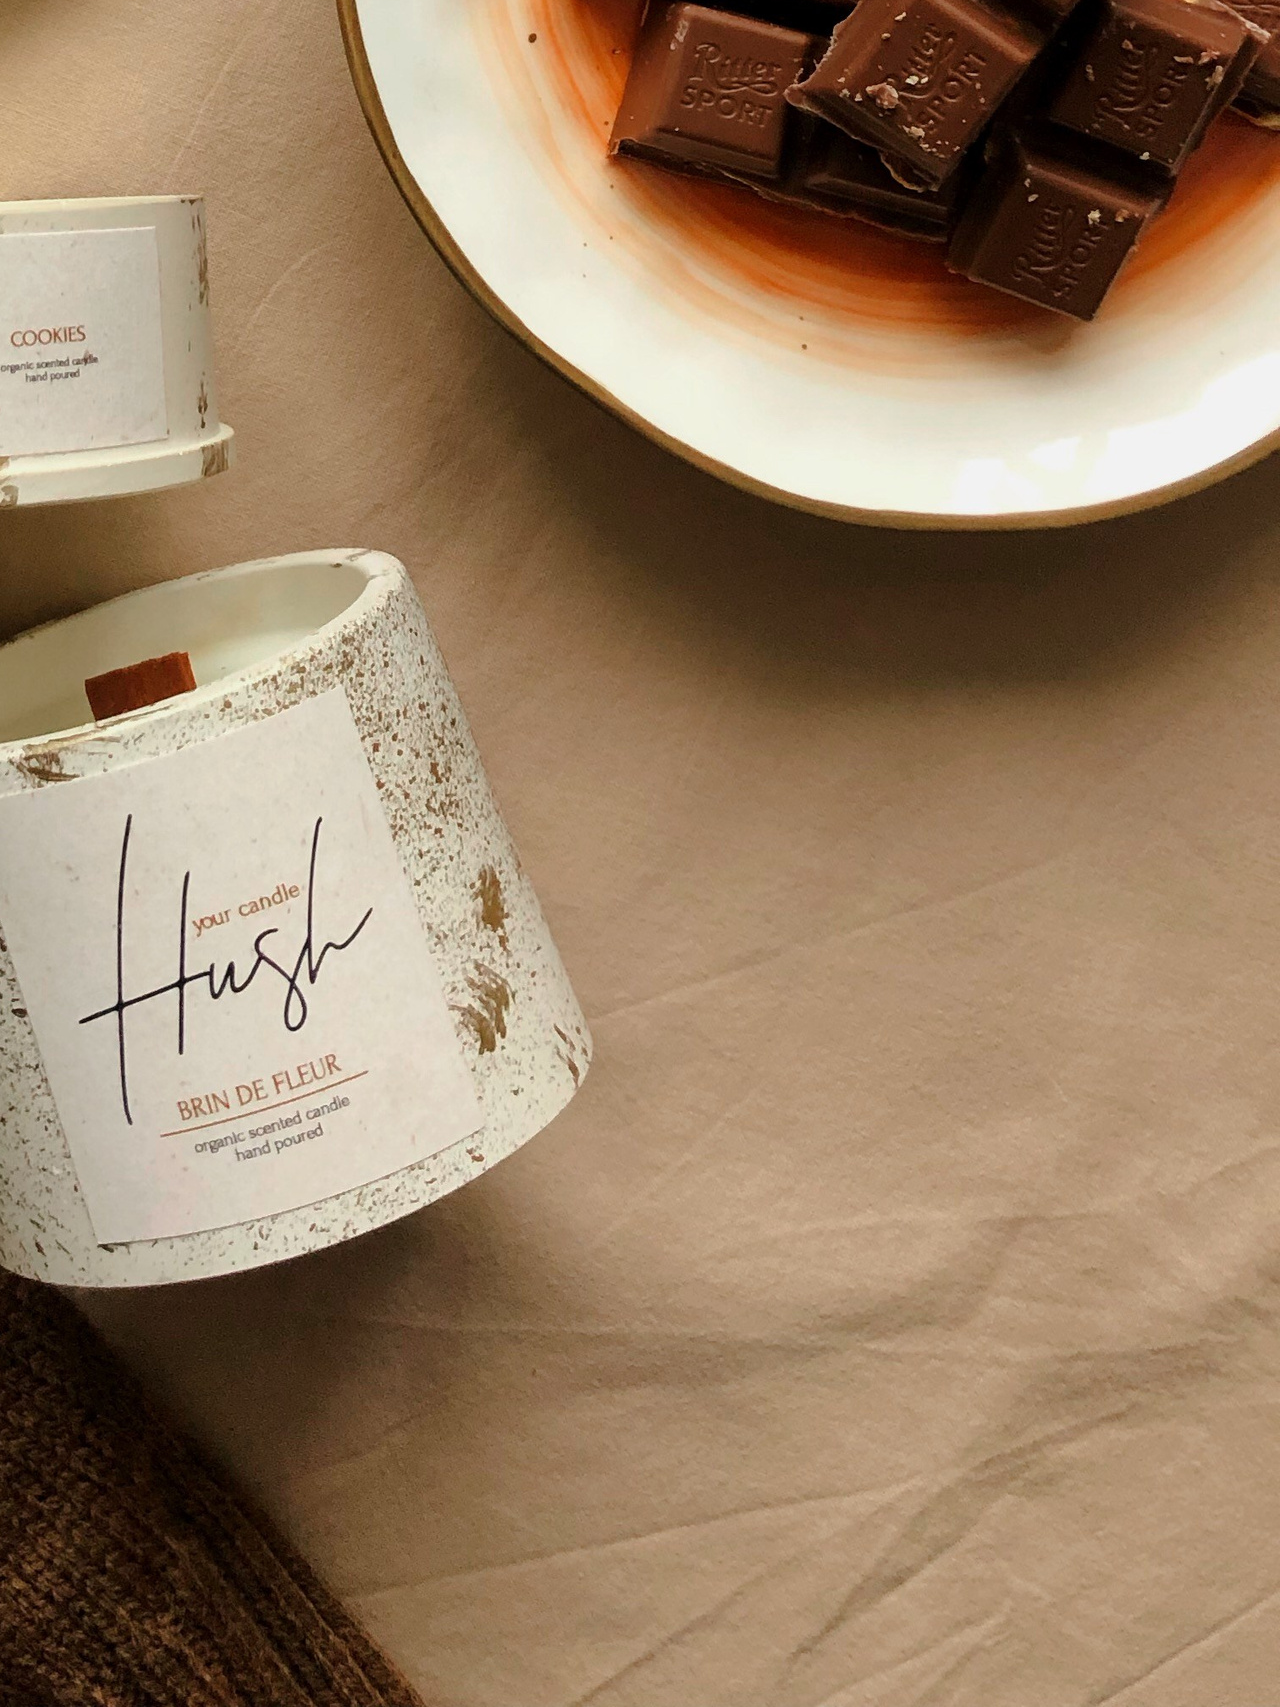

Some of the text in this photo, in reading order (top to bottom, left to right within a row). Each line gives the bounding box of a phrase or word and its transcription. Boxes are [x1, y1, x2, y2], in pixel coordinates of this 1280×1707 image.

[10, 324, 87, 348] COOKIES
[0, 352, 99, 374] organic scented candle
[25, 368, 81, 385] hand poured
[191, 882, 301, 938] your candle
[176, 1053, 342, 1122] BRIN DE FLEUR
[194, 1094, 351, 1154] organic scented candle
[235, 1122, 324, 1162] hand poured
